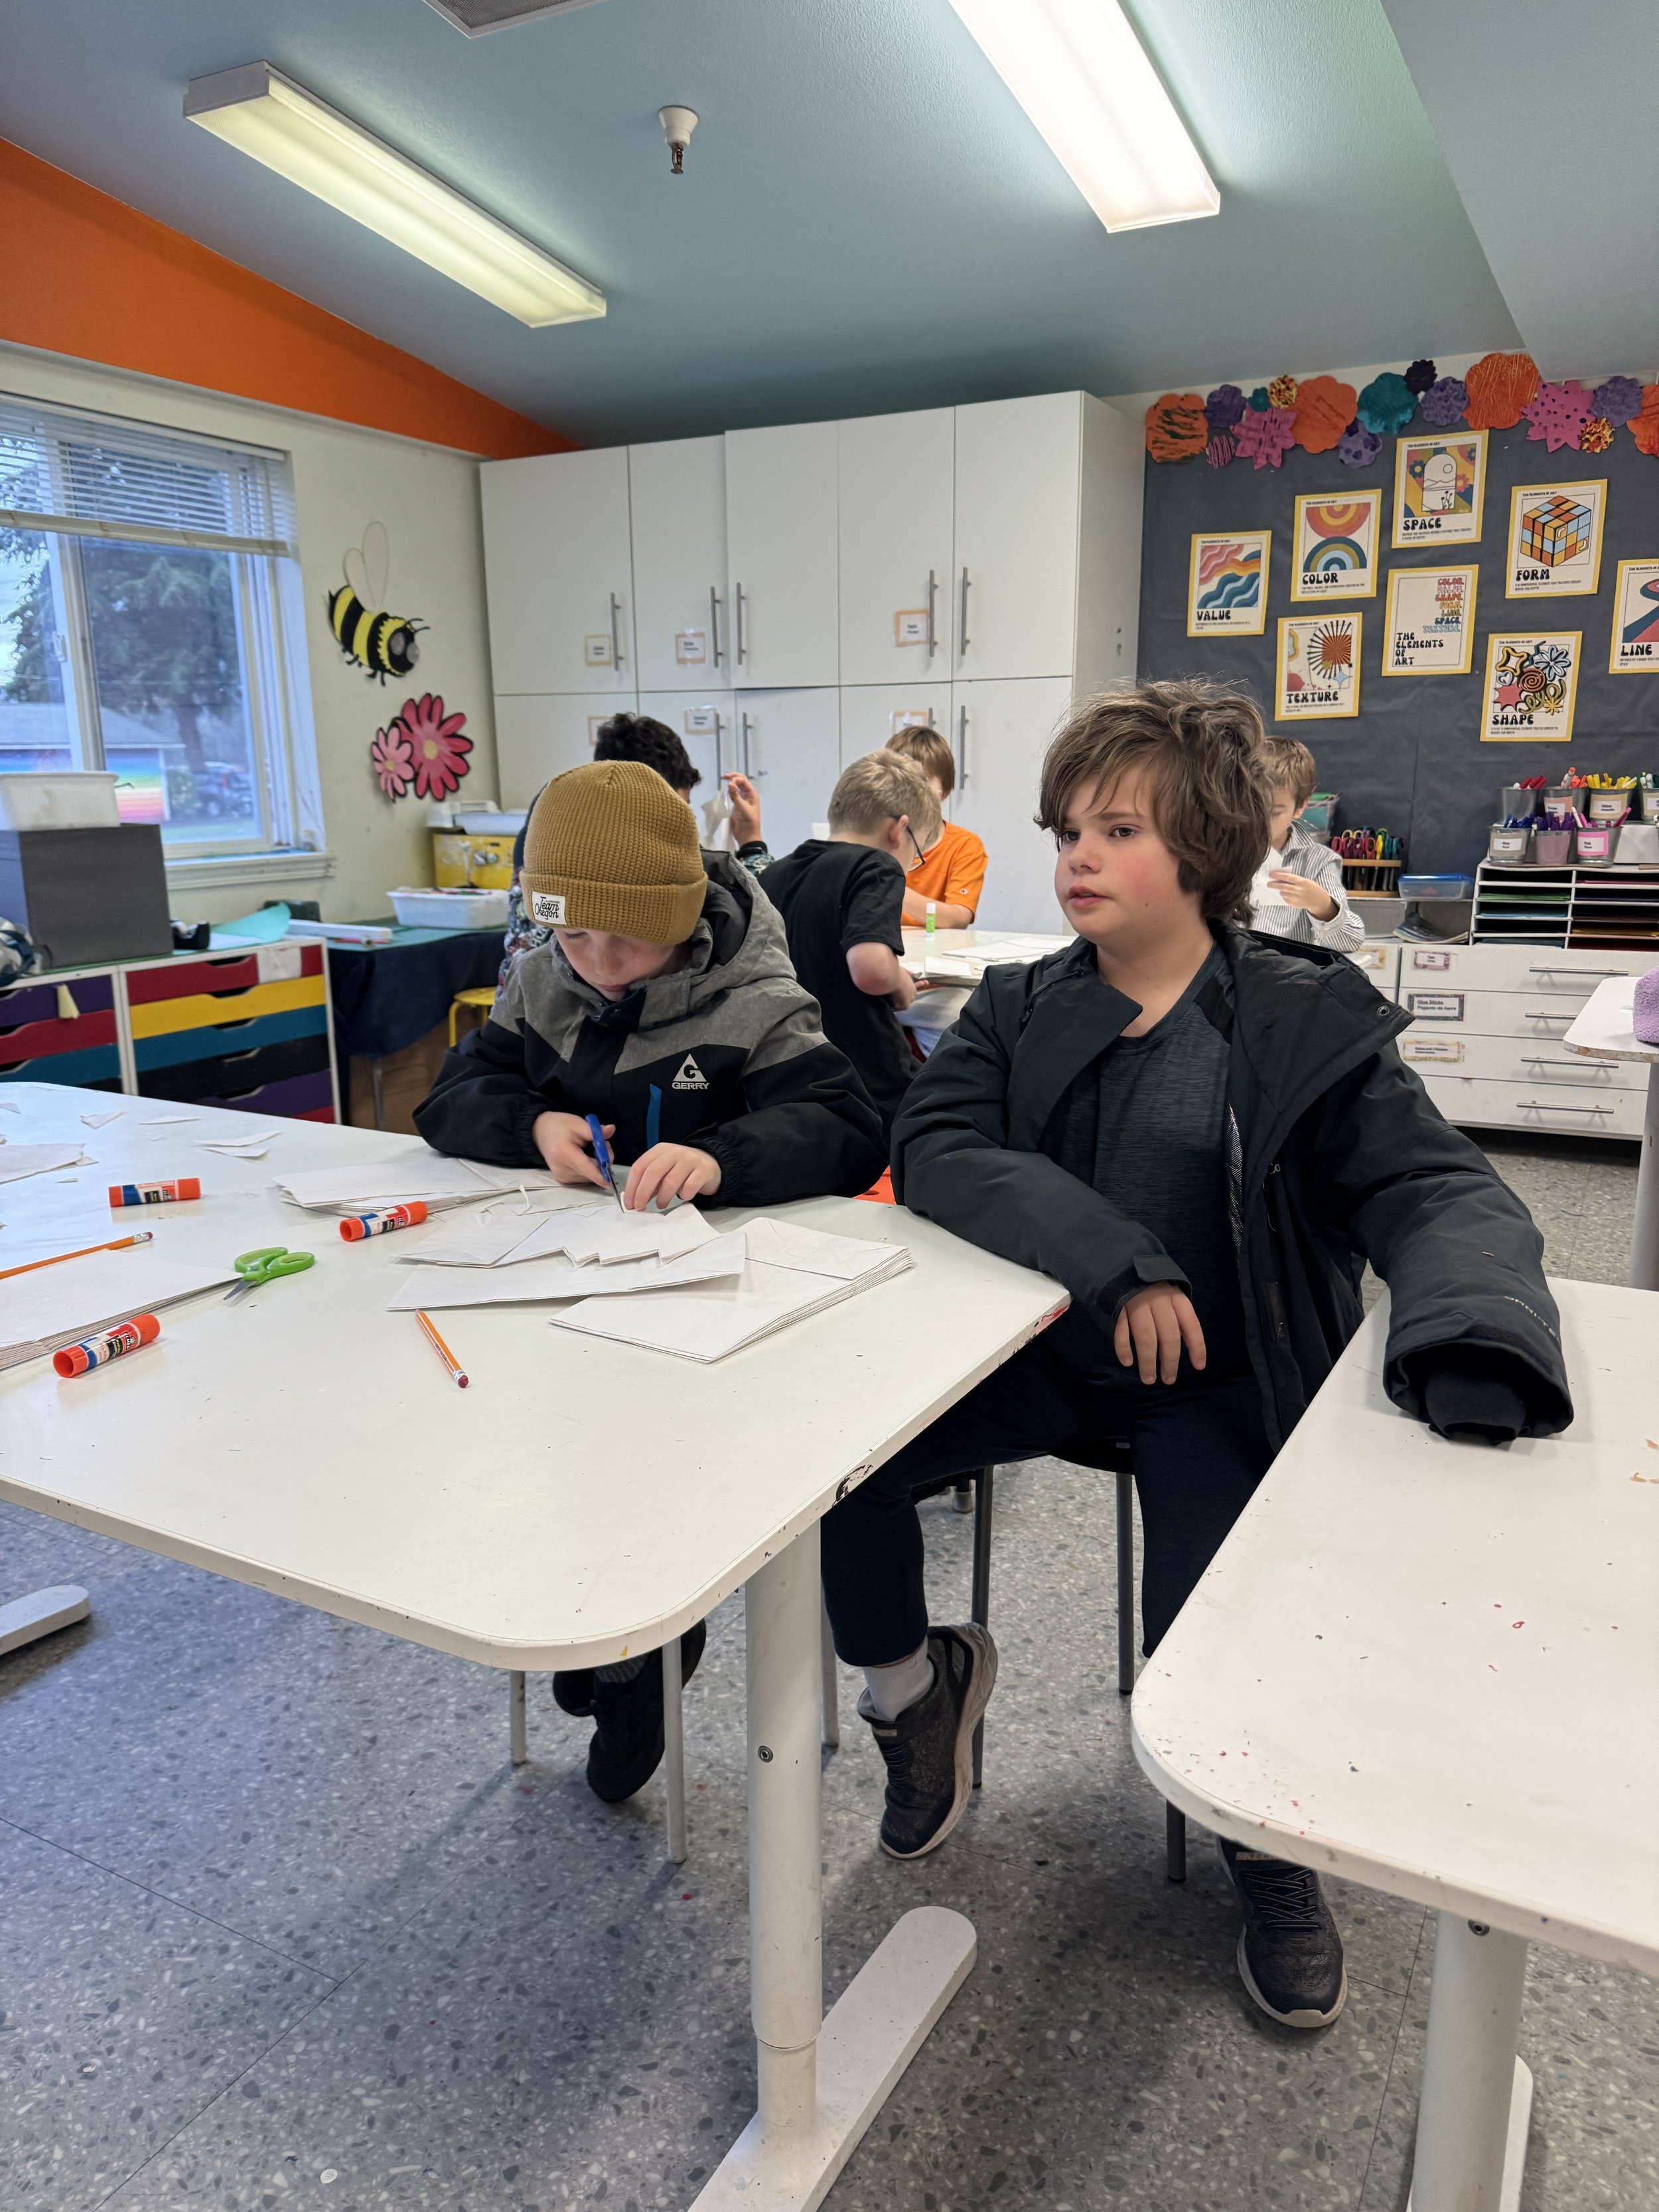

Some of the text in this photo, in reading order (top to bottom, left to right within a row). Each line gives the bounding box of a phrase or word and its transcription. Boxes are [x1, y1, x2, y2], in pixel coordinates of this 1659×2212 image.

[1403, 517, 1441, 531] SPACE
[1302, 573, 1338, 585] COLOR
[1516, 569, 1550, 581] FORM
[1196, 609, 1231, 621] VALUE
[1396, 632, 1415, 640] THE
[1396, 639, 1443, 648] ELEMENTS
[1396, 648, 1406, 657] OF
[1621, 644, 1652, 656] LINE
[1395, 656, 1415, 666] ART
[1286, 691, 1338, 704] TEXTURE
[1492, 713, 1534, 725] SHAPE
[540, 896, 559, 912] Team
[535, 903, 559, 920] Oregon
